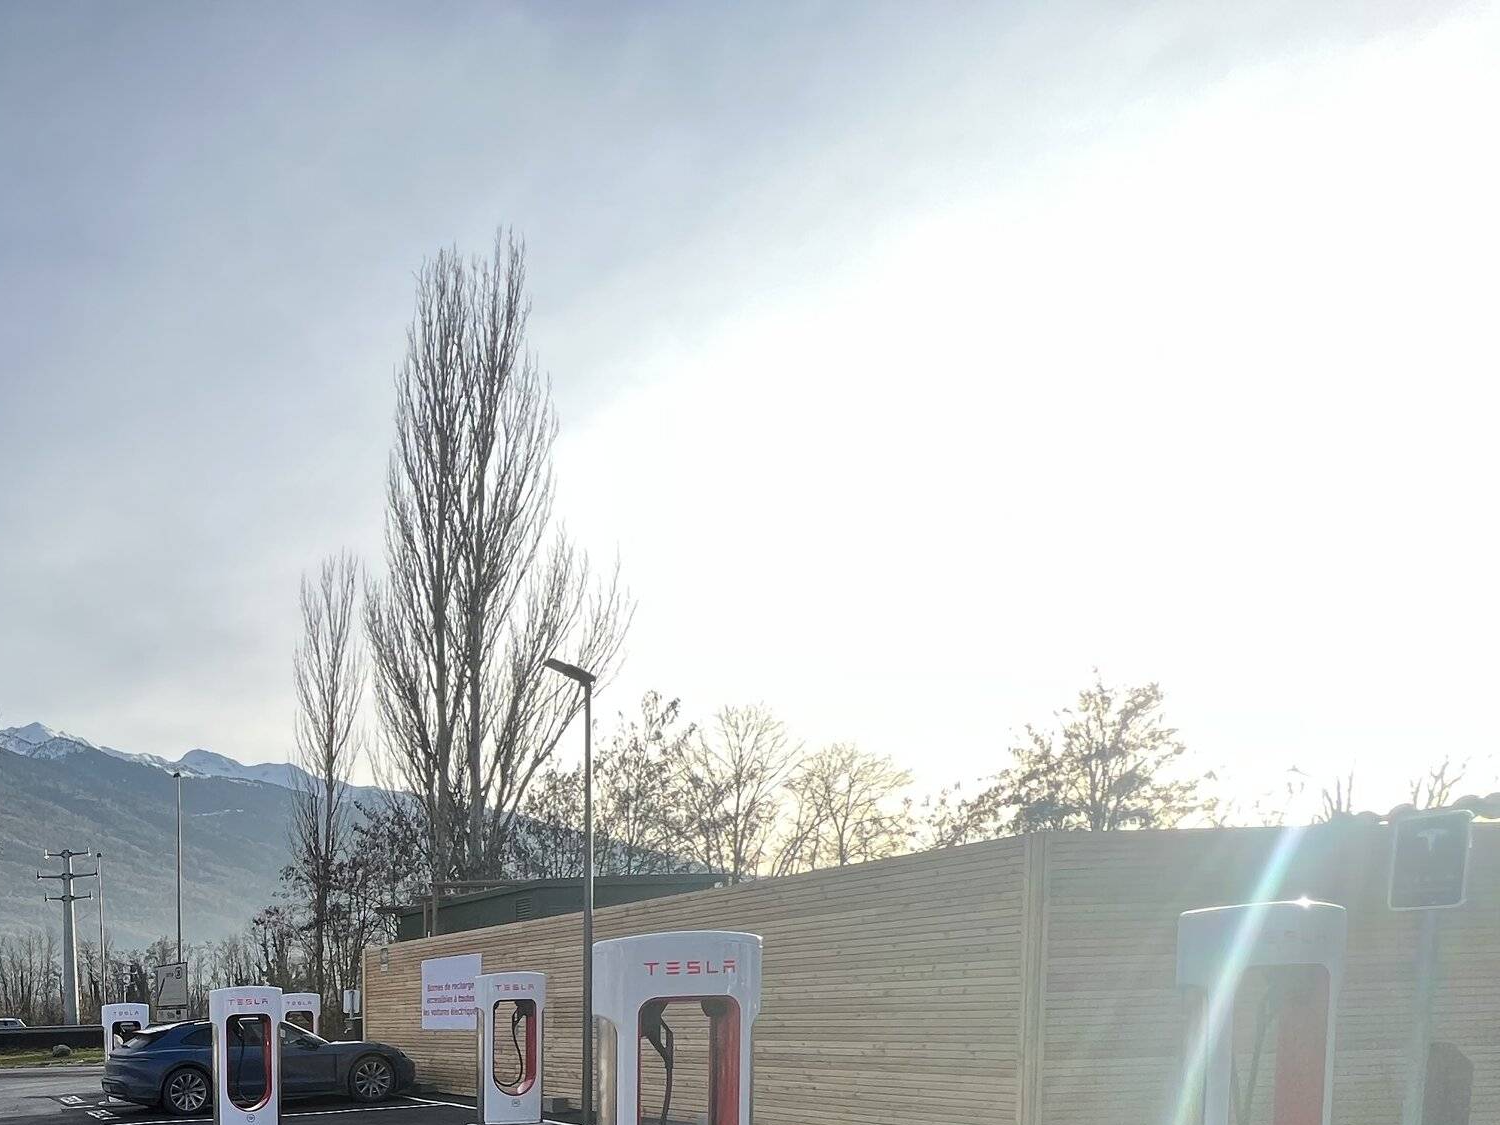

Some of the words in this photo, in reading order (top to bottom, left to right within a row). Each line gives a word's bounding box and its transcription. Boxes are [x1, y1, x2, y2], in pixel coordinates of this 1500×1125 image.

[643, 960, 736, 976] TESLA
[494, 983, 535, 992] TESLA
[228, 998, 269, 1006] TESLA
